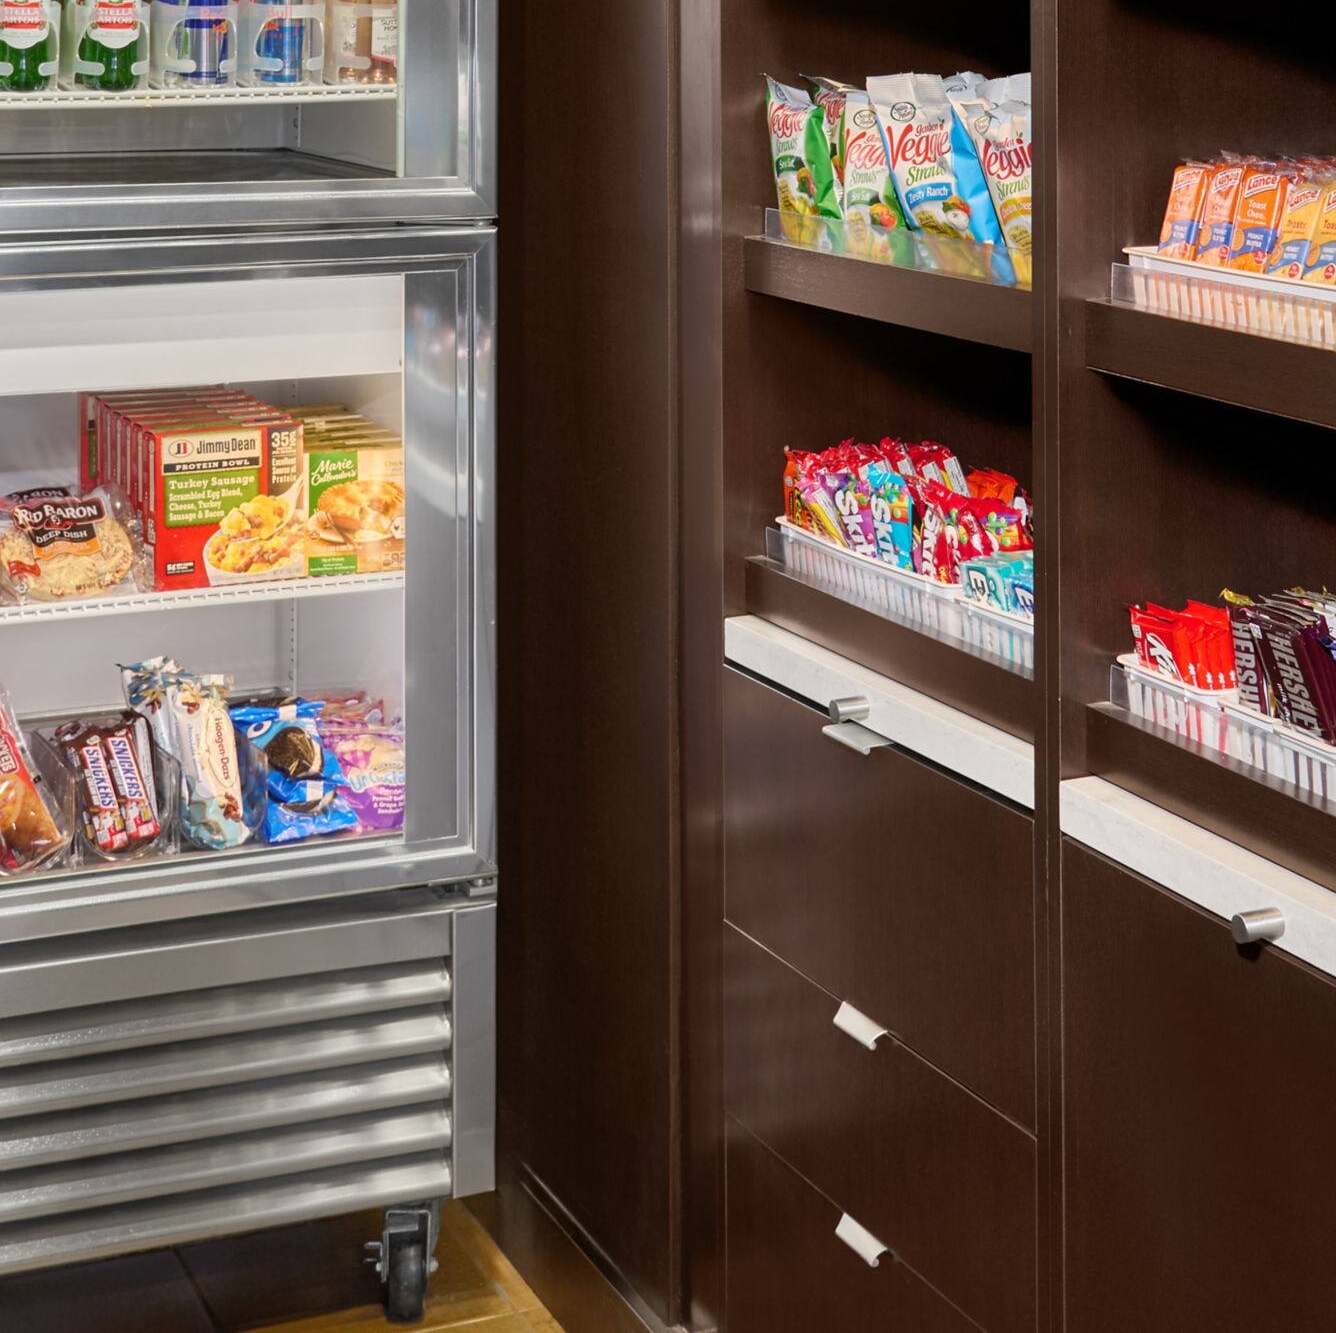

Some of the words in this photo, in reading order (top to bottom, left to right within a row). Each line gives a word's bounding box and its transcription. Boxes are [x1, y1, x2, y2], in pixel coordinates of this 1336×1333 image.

[2, 7, 40, 16] STELLA
[98, 7, 134, 16] STELLA
[0, 16, 39, 25] ARTOIS
[98, 16, 133, 25] ARTOIS
[886, 123, 952, 170] Veggie
[905, 164, 948, 187] Straws
[1247, 176, 1278, 190] Lance
[909, 190, 925, 204] Zesty
[925, 185, 949, 197] Ranch
[995, 179, 1031, 201] Straws
[1248, 199, 1267, 210] Toast
[1289, 189, 1318, 208] Lance
[1246, 239, 1262, 247] BUTTER
[1247, 232, 1264, 241] PEANUT
[196, 440, 230, 455] Jimmy
[231, 437, 257, 451] Dean
[271, 430, 297, 448] 35g
[175, 461, 219, 471] PROTEIN
[222, 458, 250, 468] BOWL
[271, 457, 297, 466] Excellent
[312, 459, 354, 475] Marie
[271, 466, 290, 475] Source
[290, 465, 297, 473] of
[311, 469, 357, 486] Callender's
[168, 478, 209, 490] Turkey
[211, 475, 255, 487] Sausage
[271, 474, 297, 484] Protein
[169, 491, 206, 502] Scrambled
[207, 489, 220, 500] Egg
[221, 487, 243, 497] Blend,
[44, 504, 98, 520] BARON
[169, 502, 197, 512] Cheese,
[199, 500, 222, 510] Turkey
[169, 511, 197, 522] Sausage
[198, 511, 203, 519] &
[204, 509, 225, 518] Bacon
[834, 490, 878, 558] Skit
[870, 493, 901, 567] Skit
[35, 529, 62, 544] DEEP
[63, 529, 88, 540] DISH
[922, 506, 946, 579] Skit
[110, 739, 143, 800] SNICKERS
[85, 748, 117, 809] SNICKERS
